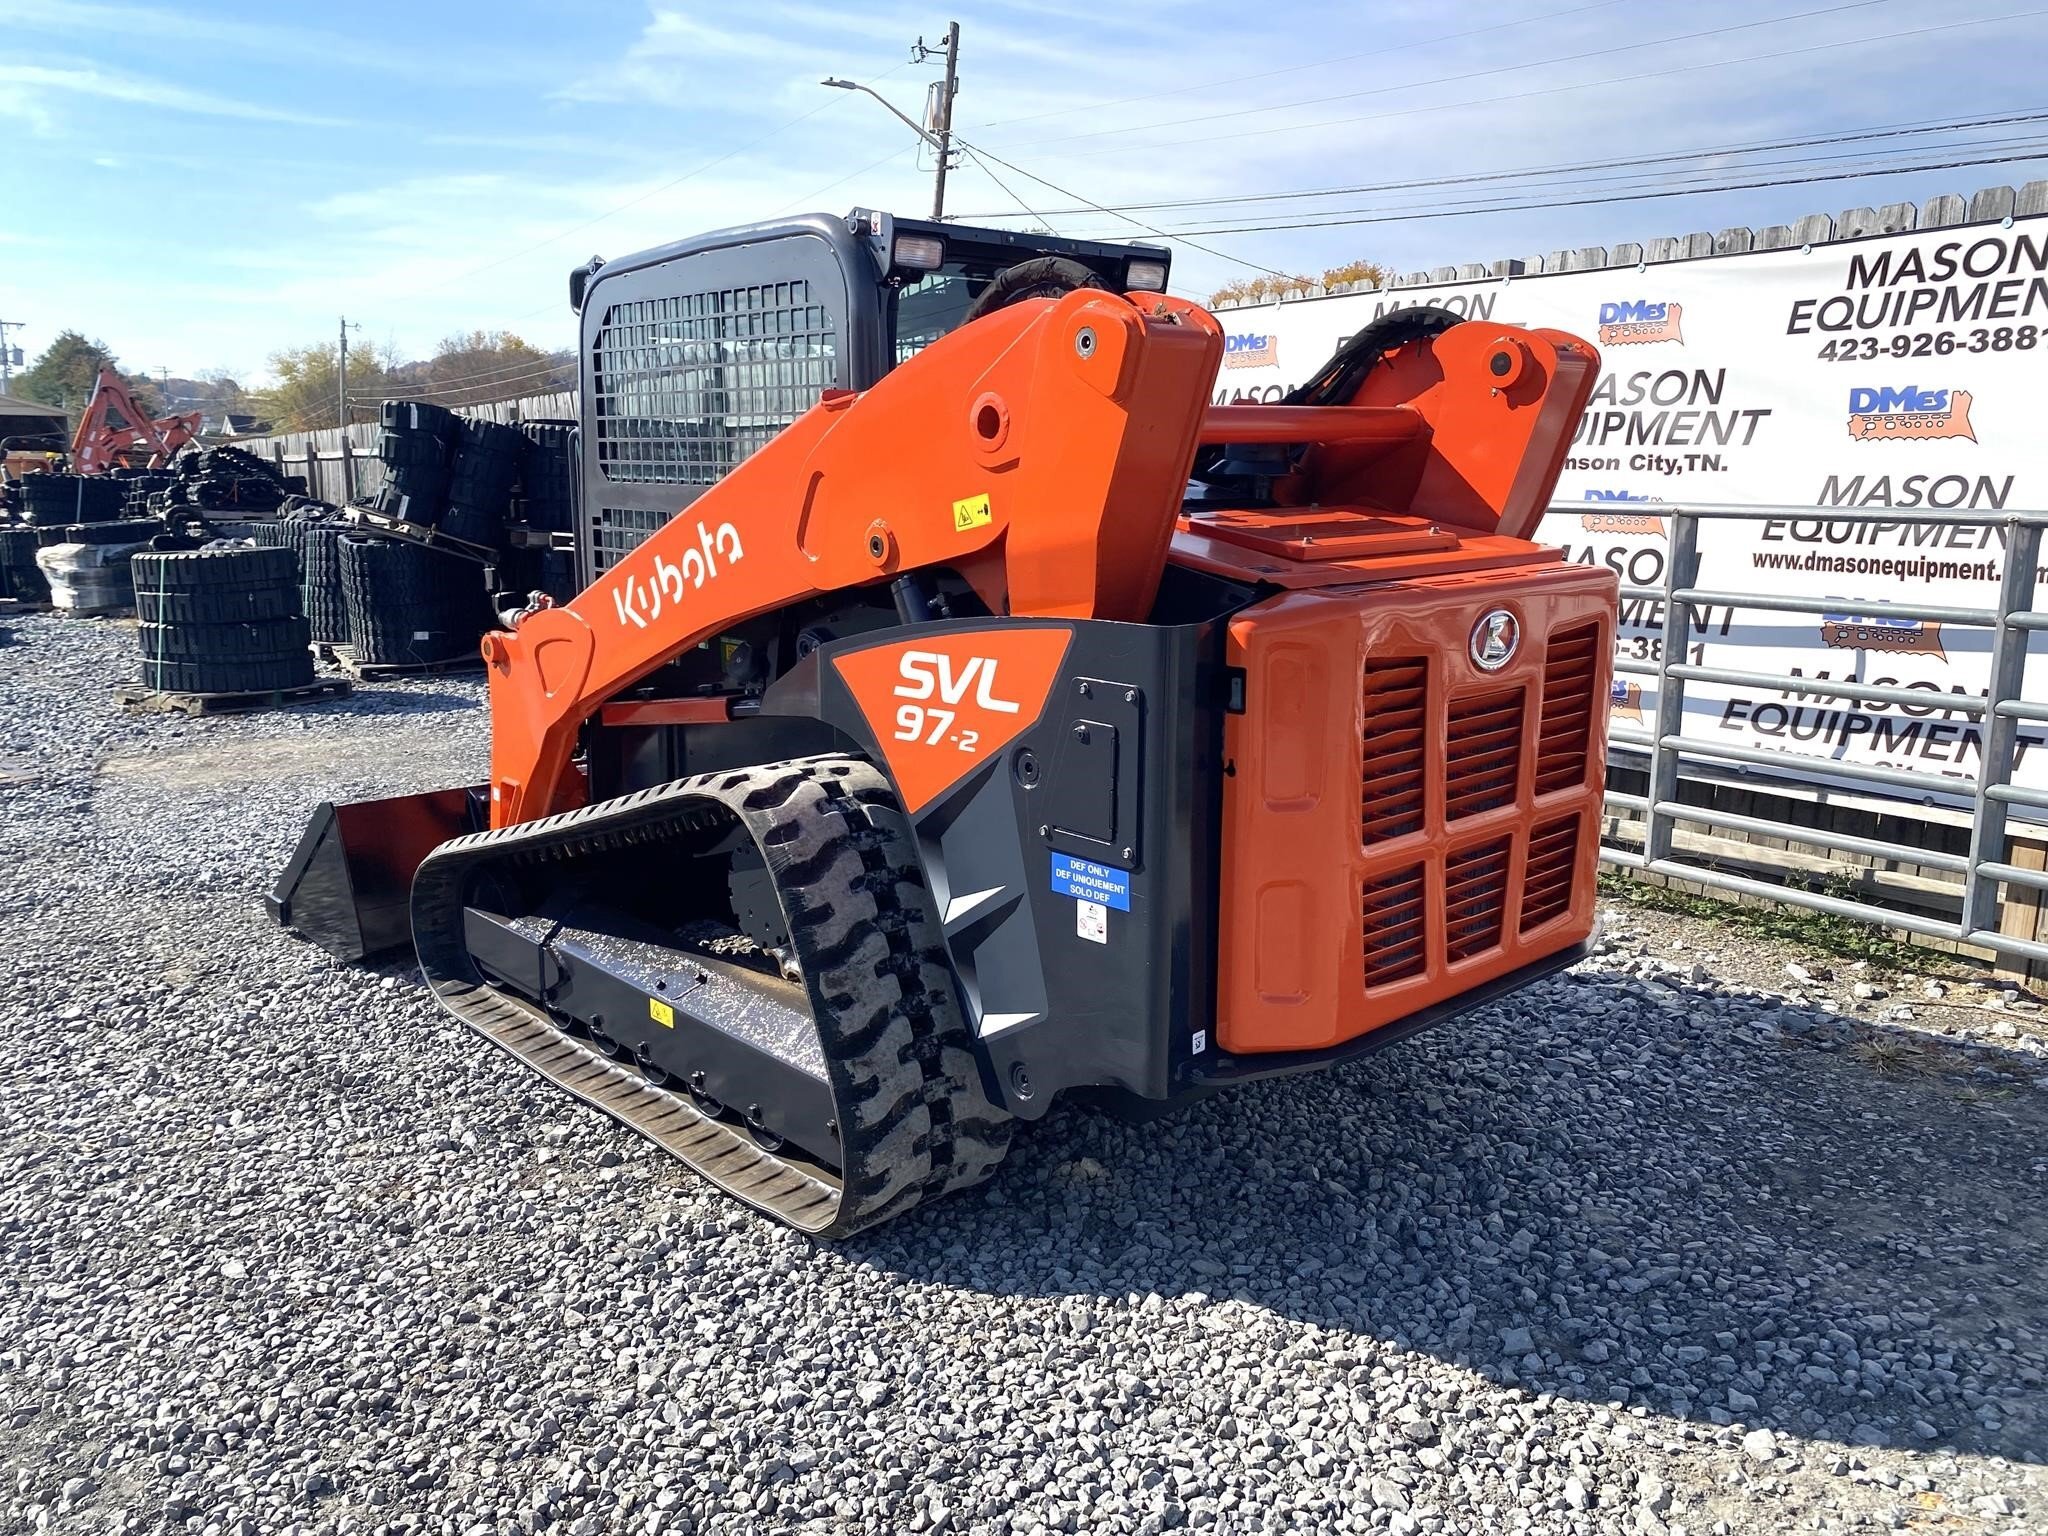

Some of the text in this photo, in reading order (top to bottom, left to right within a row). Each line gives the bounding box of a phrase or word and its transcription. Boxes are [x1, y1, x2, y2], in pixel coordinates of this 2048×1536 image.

[1846, 234, 2048, 290] MASON
[1587, 368, 1726, 407] ASON
[1629, 453, 1729, 475] City,TN.
[1816, 475, 2015, 509] MASON
[612, 521, 744, 629] Kubota
[893, 650, 1020, 714] SVL
[894, 704, 979, 753] 97-2
[1055, 868, 1125, 894] DEF UNIQUEMENT
[1070, 860, 1109, 878] DEF ONLY
[1070, 884, 1110, 902] SOLO DEF
